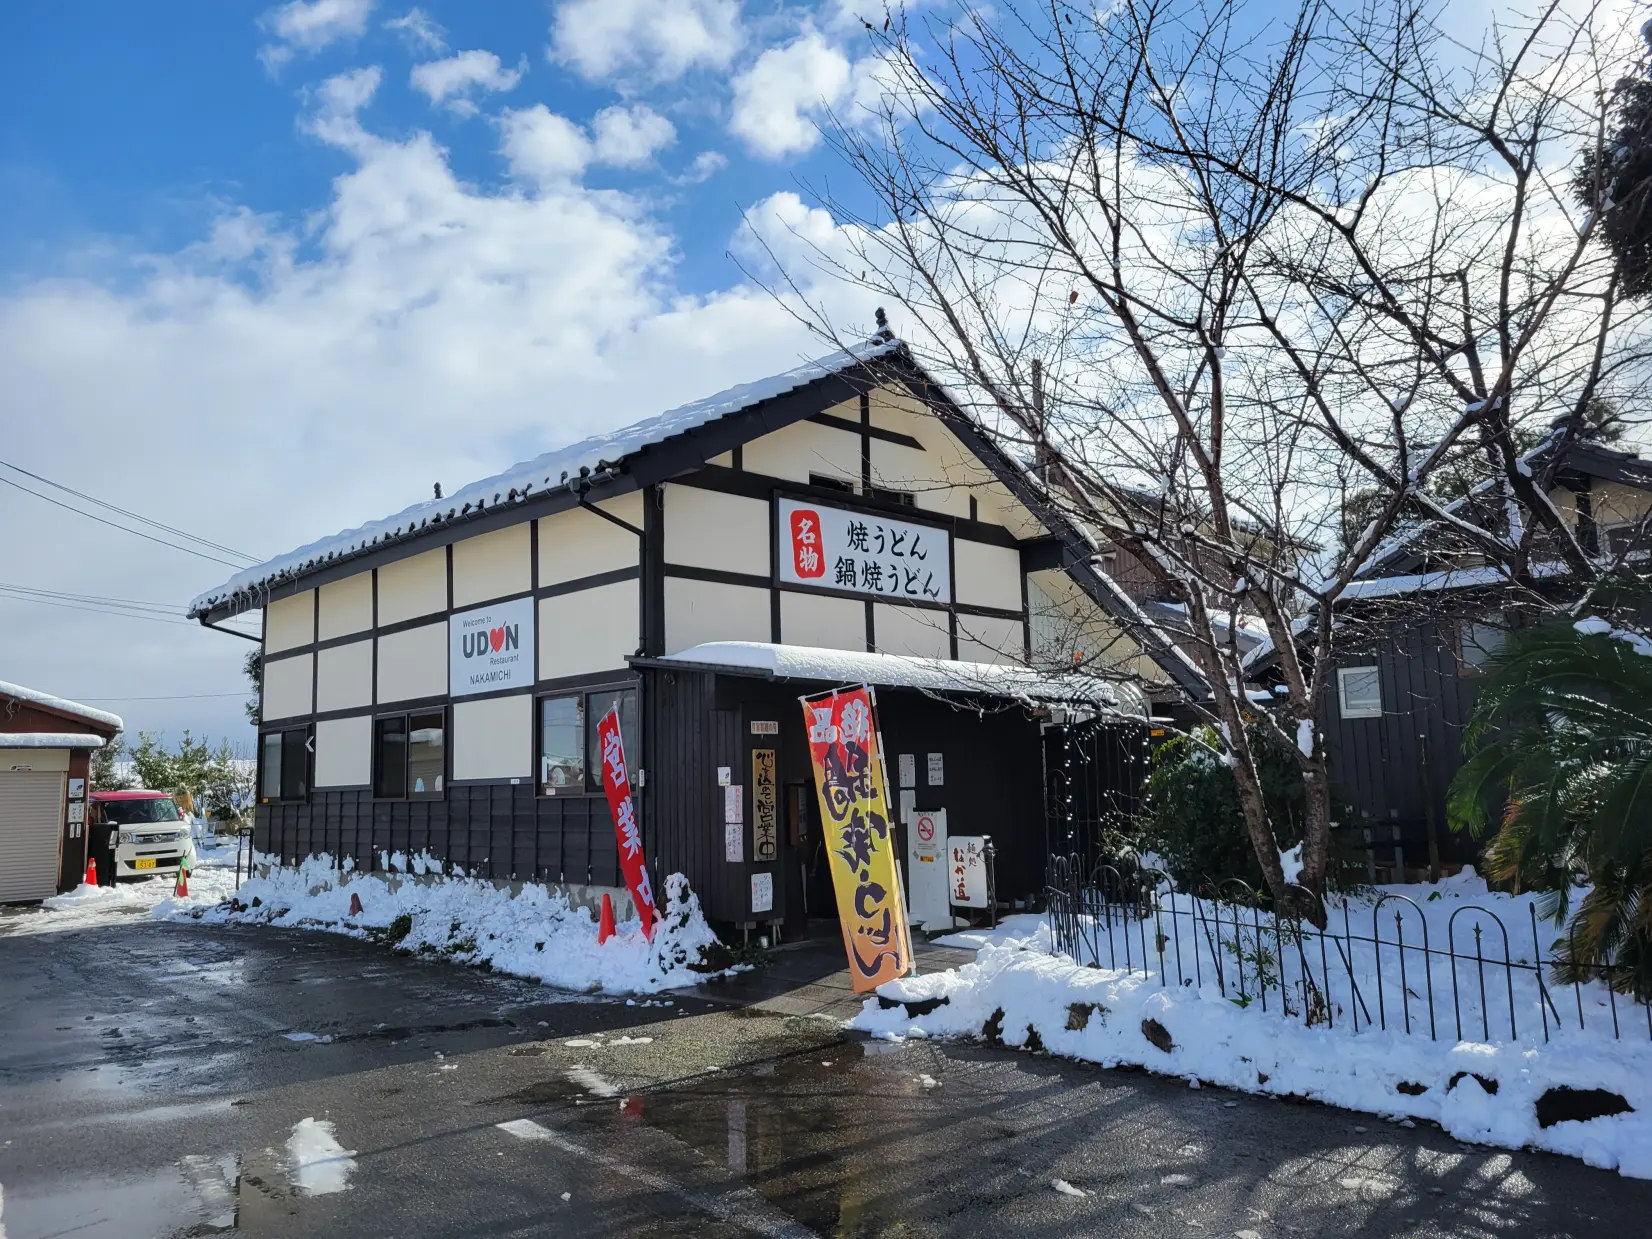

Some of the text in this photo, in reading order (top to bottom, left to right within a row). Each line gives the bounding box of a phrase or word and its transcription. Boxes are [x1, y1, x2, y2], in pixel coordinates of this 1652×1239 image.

[797, 518, 819, 572] 名物
[847, 520, 928, 561] 焼うどん
[834, 555, 941, 598] 鍋焼うどん
[463, 617, 485, 628] Welcome
[470, 669, 511, 686] NAKAMICHI
[490, 654, 519, 666] Restaurant
[603, 728, 656, 908] 営業中
